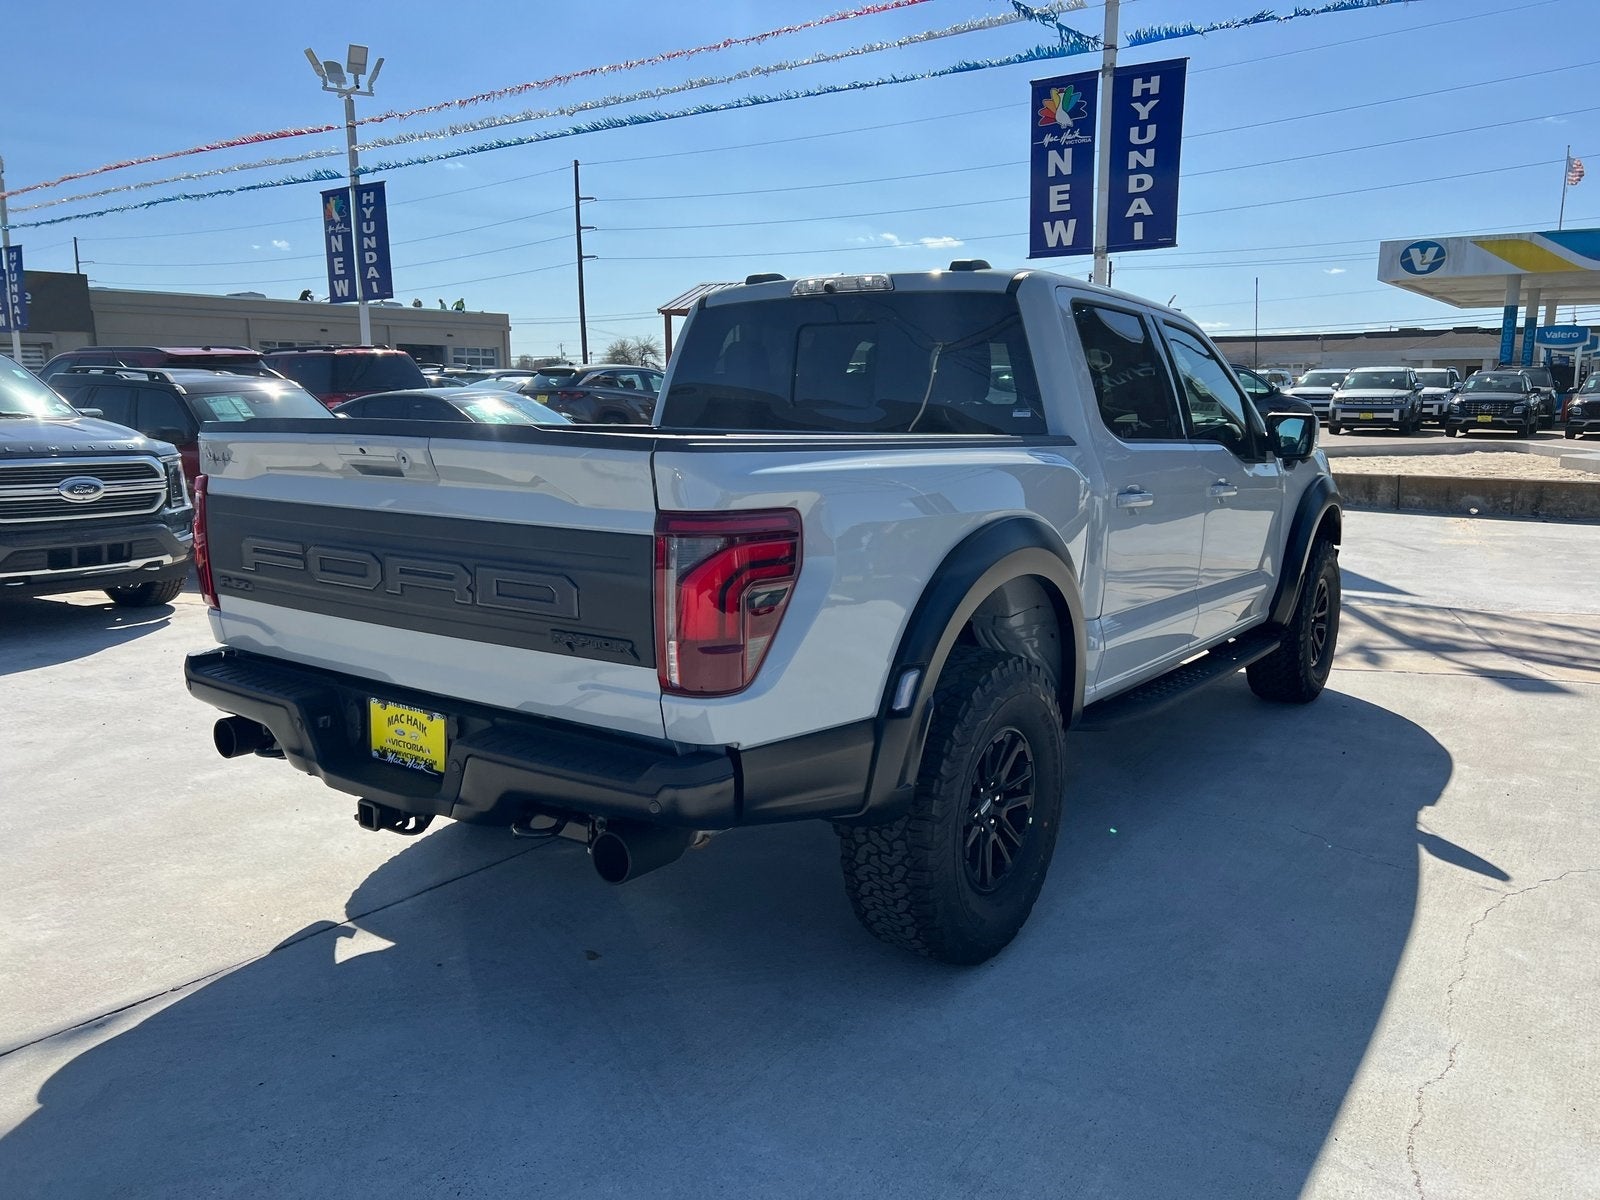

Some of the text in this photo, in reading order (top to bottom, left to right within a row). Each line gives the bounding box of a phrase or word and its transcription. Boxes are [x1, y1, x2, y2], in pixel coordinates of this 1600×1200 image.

[1125, 74, 1161, 241] HYUNDAI
[1042, 147, 1077, 248] NEW
[330, 234, 350, 298] NEW
[362, 191, 380, 294] HYUNDAI
[9, 251, 21, 325] HYUNDAI
[1545, 331, 1579, 339] Valero
[73, 484, 95, 494] Ford
[241, 536, 581, 620] FORD
[550, 629, 640, 661] RAPTOR
[387, 713, 405, 728] MAC
[406, 715, 428, 737] HAIK
[390, 738, 425, 754] VICTORIA
[384, 753, 406, 766] Mac
